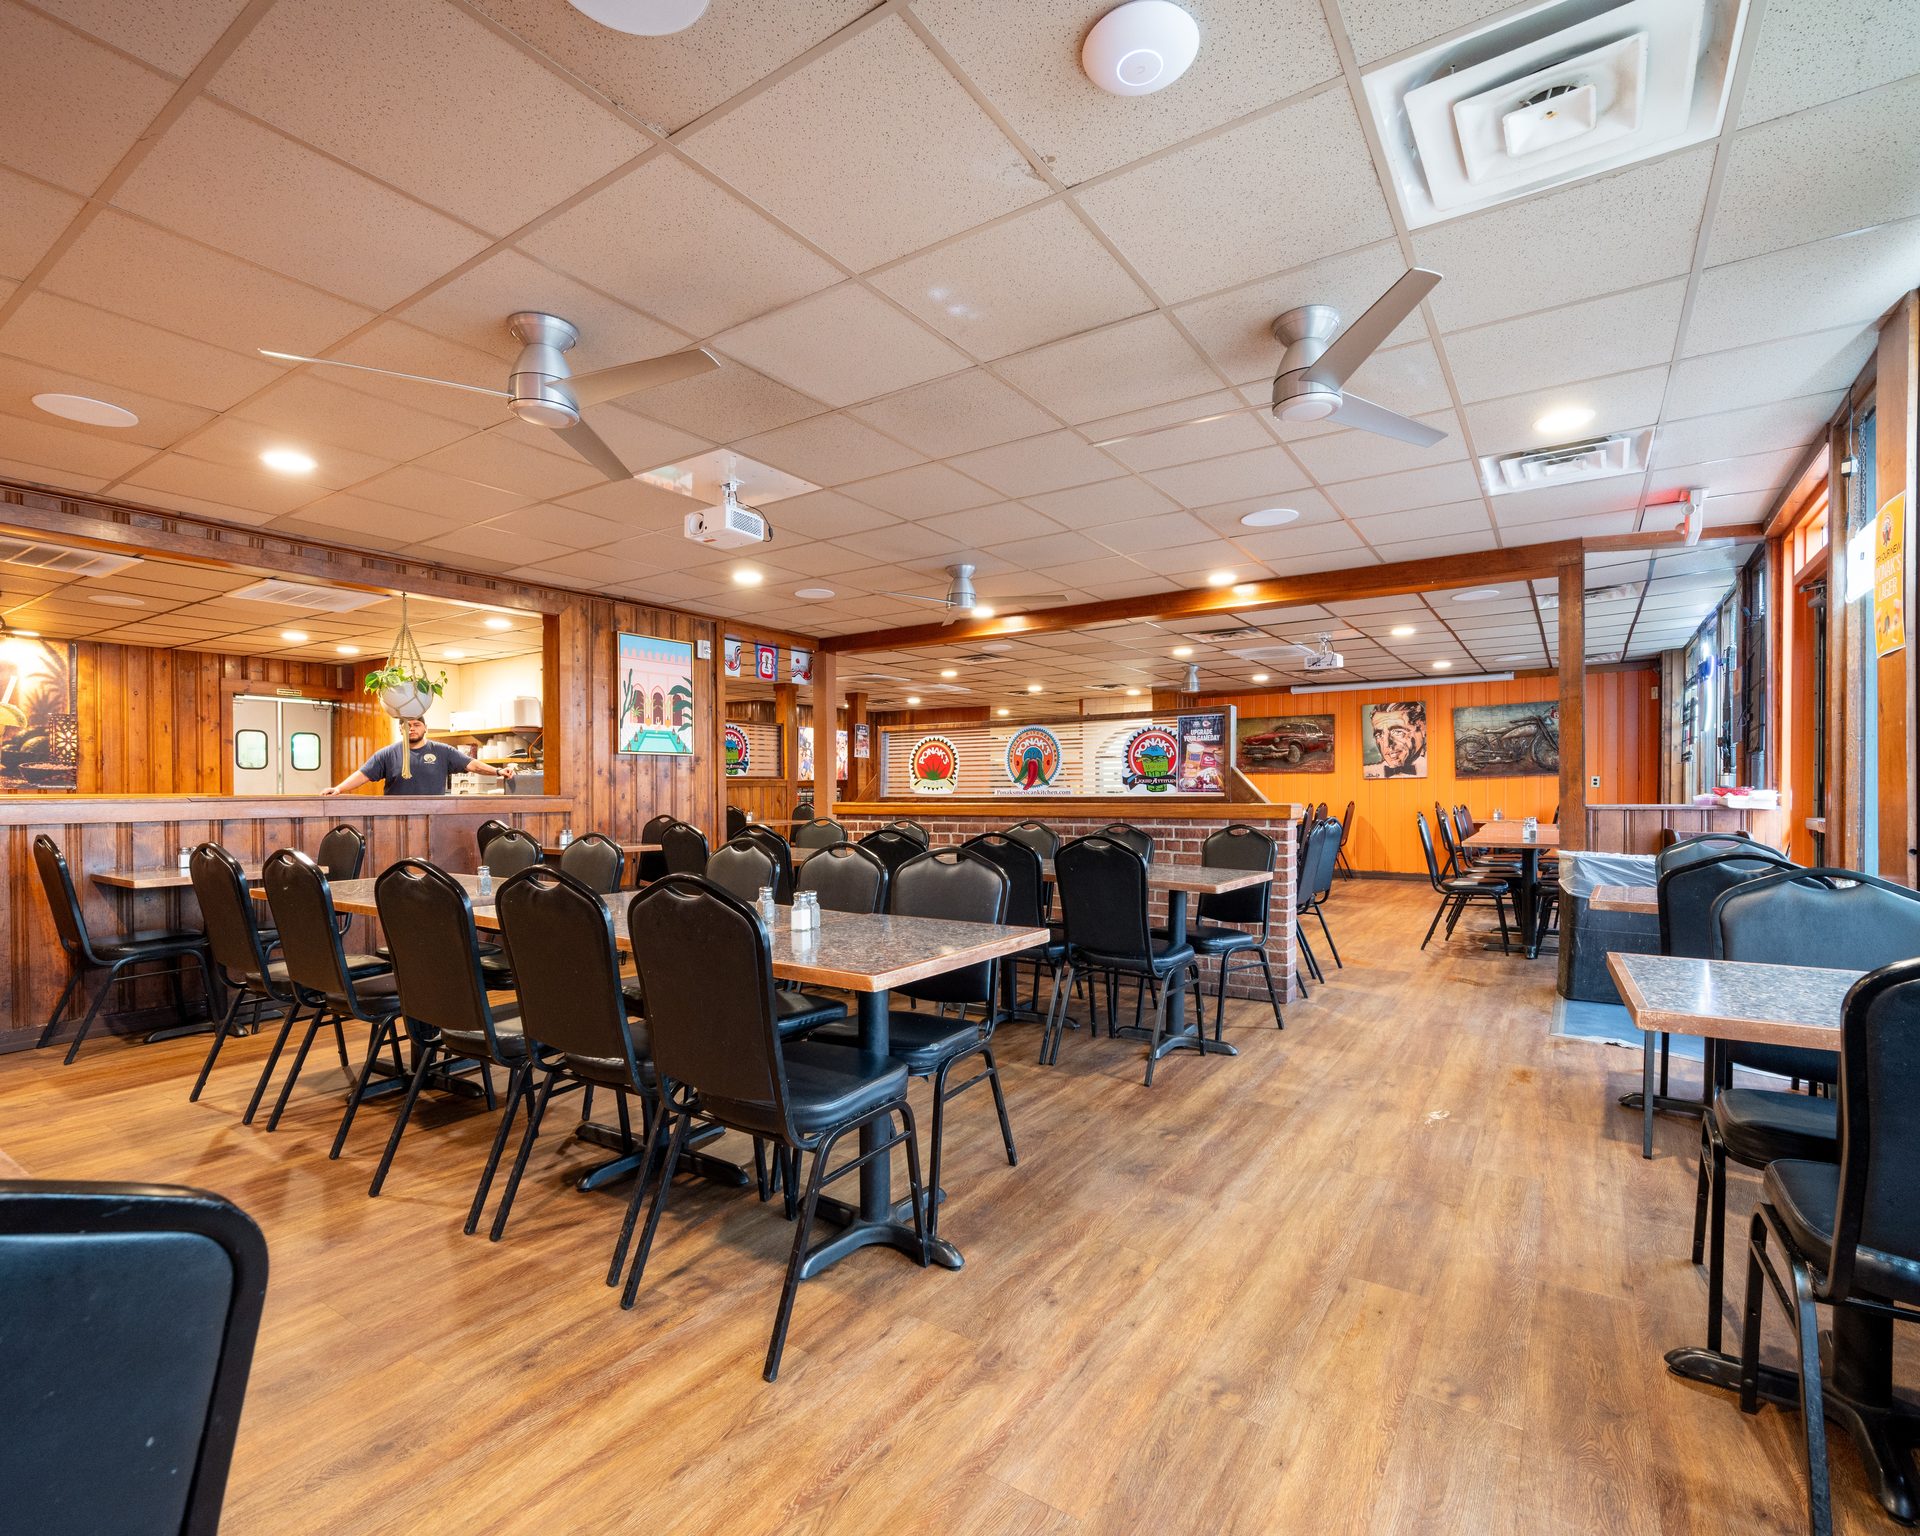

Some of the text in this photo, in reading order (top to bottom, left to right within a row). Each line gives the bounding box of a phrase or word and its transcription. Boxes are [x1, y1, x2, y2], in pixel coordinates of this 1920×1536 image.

[918, 747, 949, 765] PONAK'S
[1016, 737, 1051, 756] PONAK'S
[1134, 738, 1175, 758] PONAK'S
